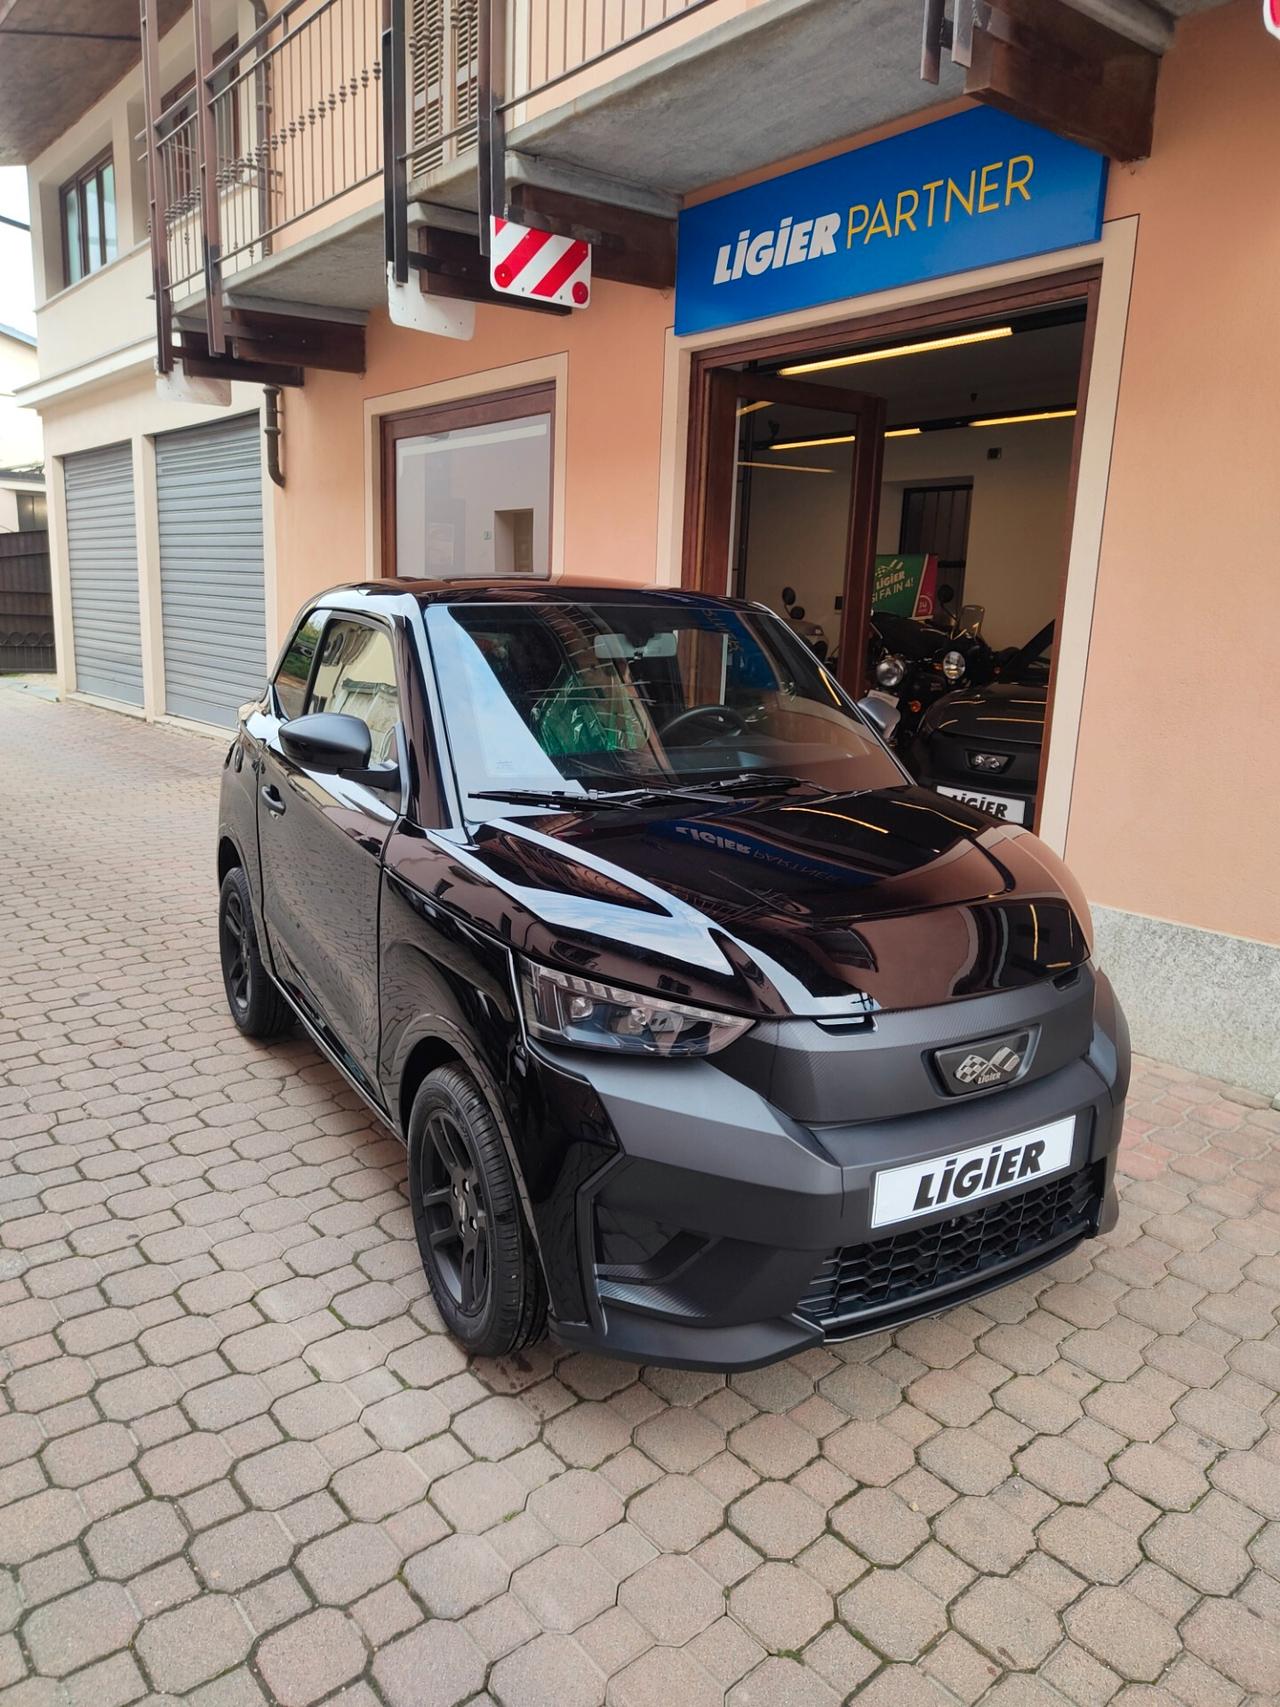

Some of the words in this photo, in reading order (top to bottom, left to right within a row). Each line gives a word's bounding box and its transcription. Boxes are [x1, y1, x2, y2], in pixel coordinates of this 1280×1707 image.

[846, 154, 1035, 249] PARTNER
[879, 588, 891, 599] FA
[893, 583, 903, 594] IN
